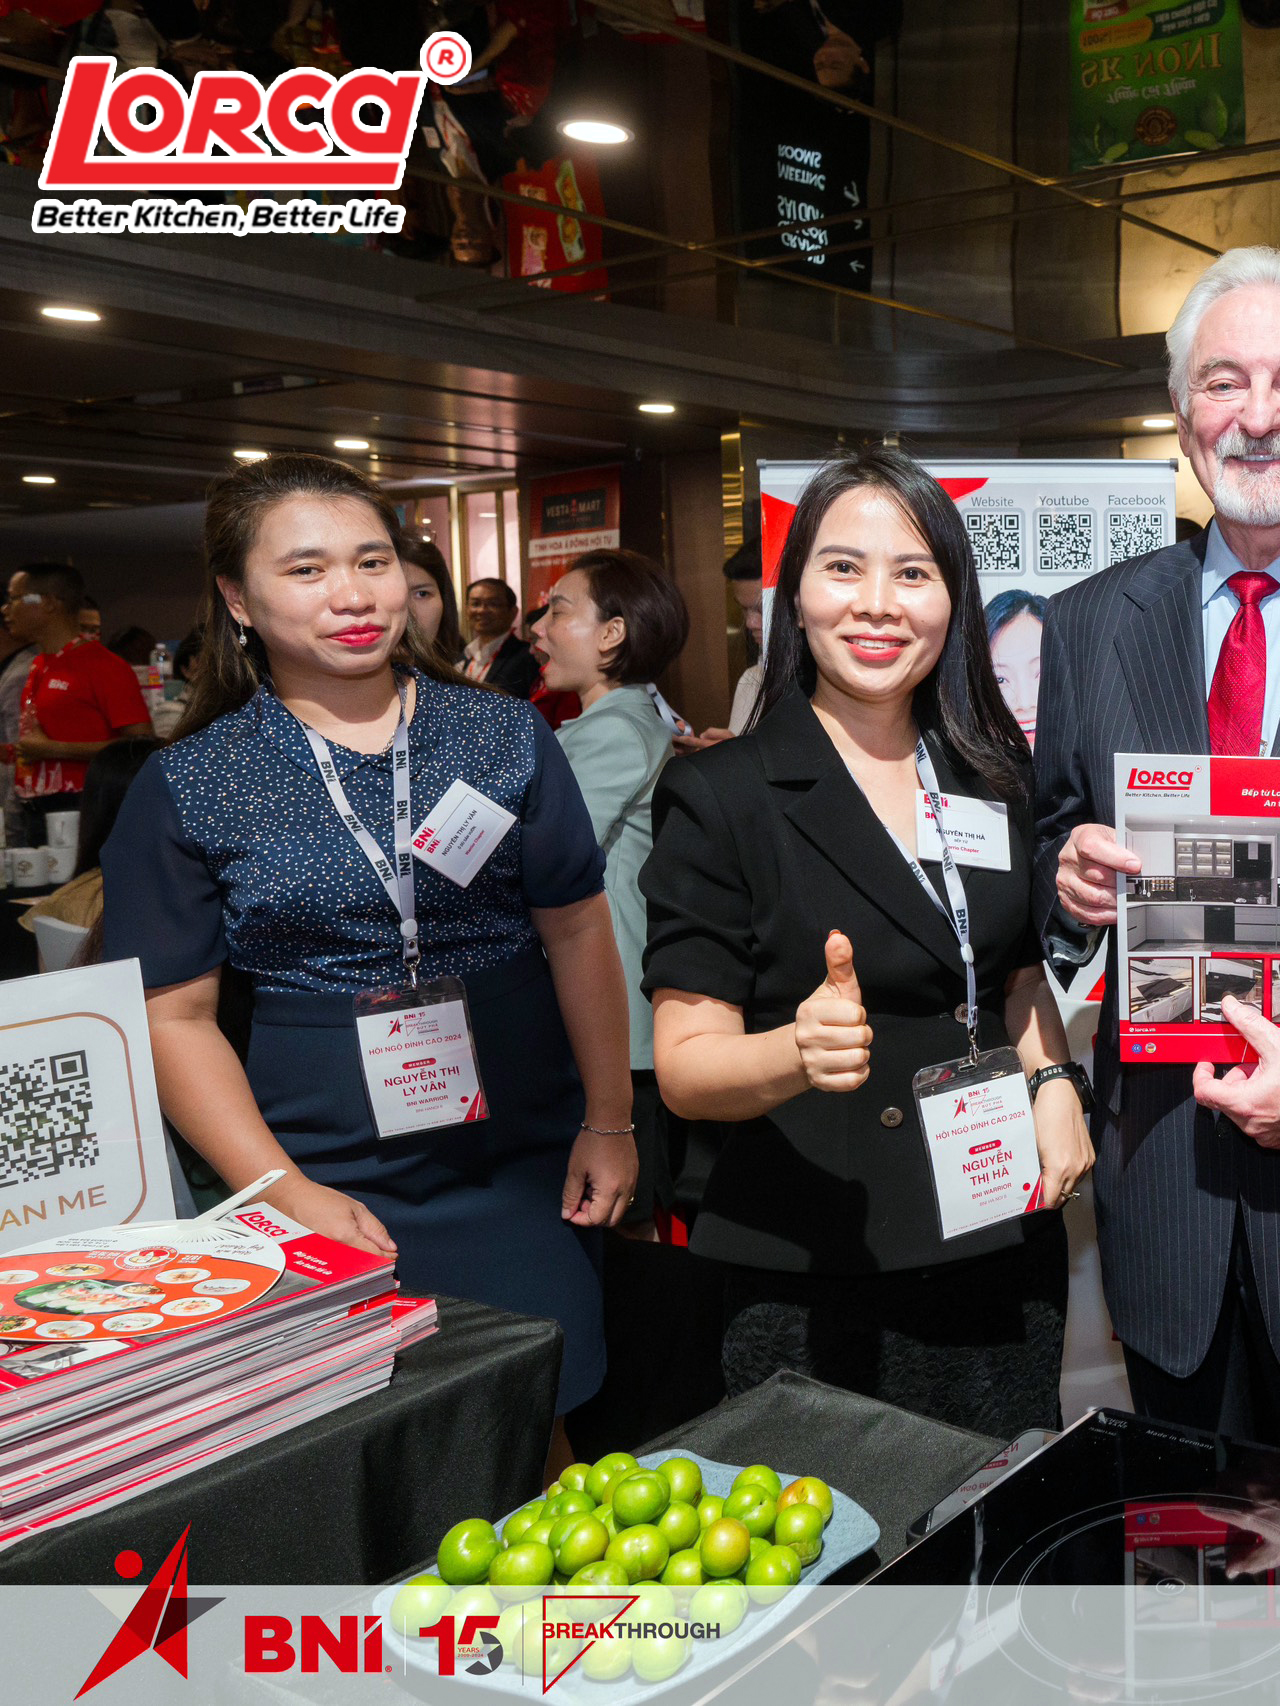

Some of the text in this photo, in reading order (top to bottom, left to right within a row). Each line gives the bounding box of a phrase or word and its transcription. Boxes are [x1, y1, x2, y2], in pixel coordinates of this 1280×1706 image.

[971, 494, 1166, 507] Website Youtube Facebook
[1242, 788, 1260, 798] Bếp
[1264, 800, 1277, 808] An
[425, 1037, 443, 1046] CAO
[444, 1033, 462, 1042] 2024
[384, 1065, 460, 1088] NGUYỄN THỊ
[402, 1086, 418, 1097] LY
[419, 1095, 449, 1106] WARRIOR
[991, 1115, 1008, 1126] CAO
[1009, 1110, 1026, 1121] 2024
[962, 1149, 1013, 1174] NGUYỄN
[970, 1165, 1010, 1187] THỊ HÀ
[972, 1182, 1012, 1200] BNI WARRIOR
[58, 1185, 108, 1216] ME
[1146, 1428, 1214, 1450] Made in Germany
